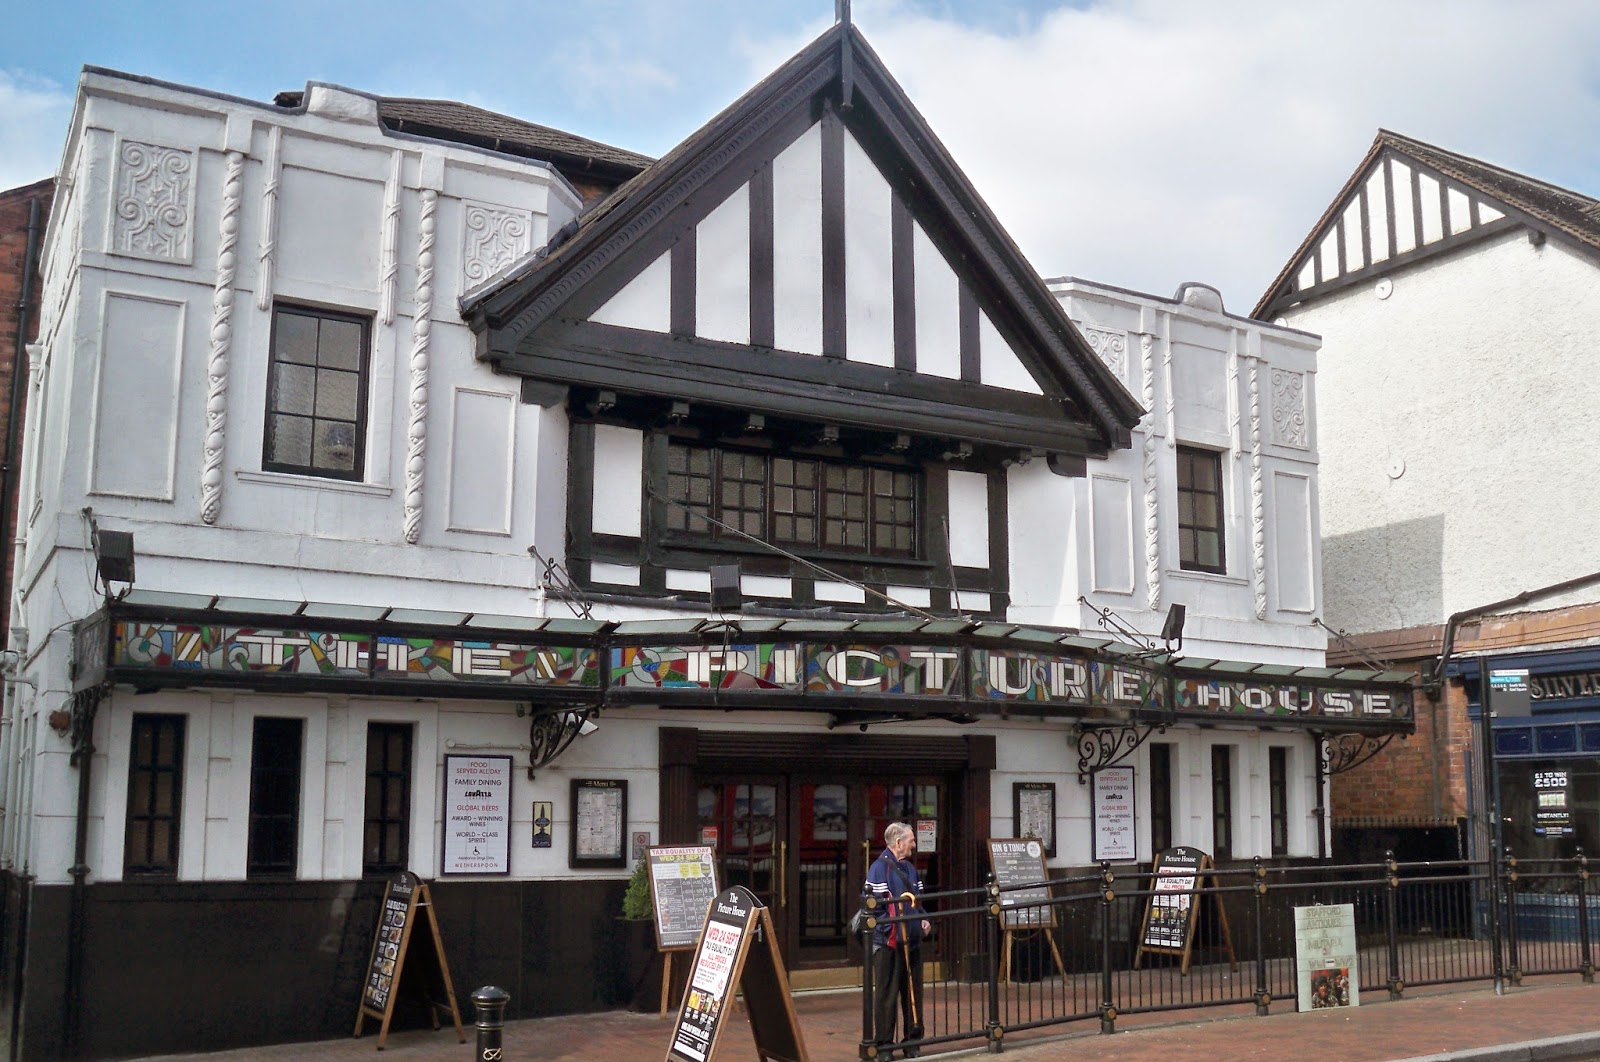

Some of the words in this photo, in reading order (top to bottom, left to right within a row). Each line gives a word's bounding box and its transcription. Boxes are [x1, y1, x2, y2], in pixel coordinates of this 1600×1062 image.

[687, 650, 1142, 701] PICTURE
[1197, 685, 1391, 714] HOUSE
[454, 778, 477, 786] FAMILY
[1534, 777, 1568, 788] £500
[991, 843, 1003, 852] GIN
[1002, 843, 1008, 852] &
[1008, 843, 1026, 852] TONIC
[685, 853, 702, 861] SEPT
[729, 892, 739, 904] The
[717, 902, 732, 915] Picture
[731, 905, 746, 917] House
[1306, 907, 1341, 917] STAFFORD
[708, 927, 719, 941] WED
[726, 932, 740, 946] SEPT
